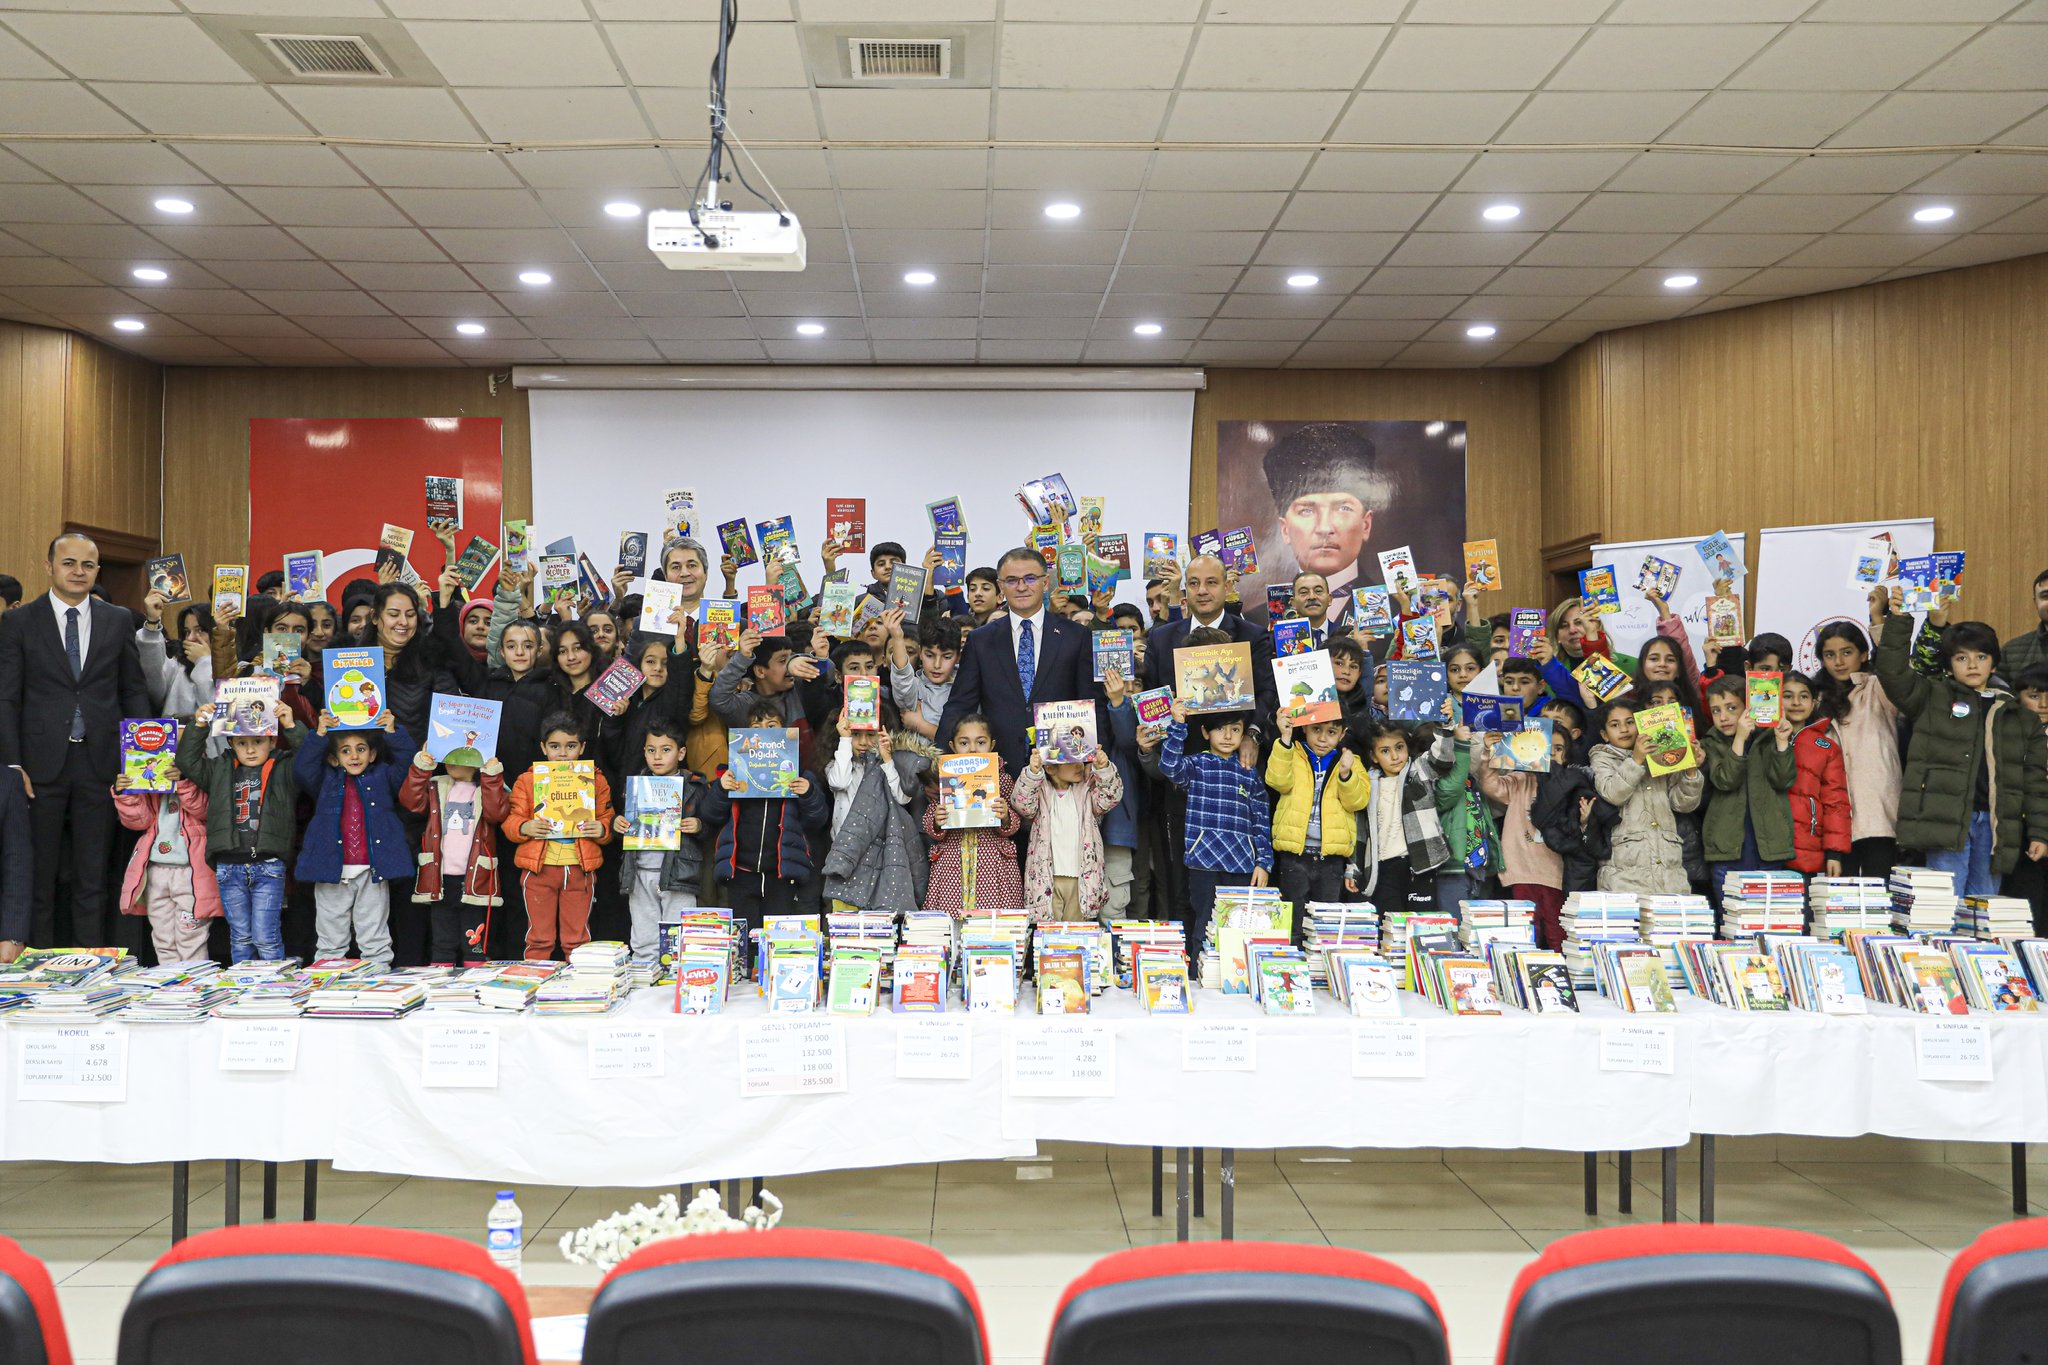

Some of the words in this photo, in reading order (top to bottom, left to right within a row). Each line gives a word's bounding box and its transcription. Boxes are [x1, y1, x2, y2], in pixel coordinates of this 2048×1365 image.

[388, 534, 403, 542] NEFES
[382, 538, 406, 548] ALMADAN
[750, 594, 772, 603] SÜPER
[1191, 648, 1218, 657] Tombik
[1220, 648, 1233, 656] Ayı
[332, 658, 374, 668] BİTKİLER
[1392, 667, 1422, 676] Sessizliğin
[943, 758, 989, 769] ARKADAŞIM
[953, 766, 965, 774] YO
[551, 792, 578, 802] ÇÖLLER
[684, 969, 715, 979] LEVENT
[789, 1022, 820, 1030] TOPLAM
[58, 1029, 90, 1037] İLKOKUL
[804, 1034, 829, 1042] 35.000
[803, 1063, 832, 1071] 118.000
[803, 1077, 833, 1086] 285.500
